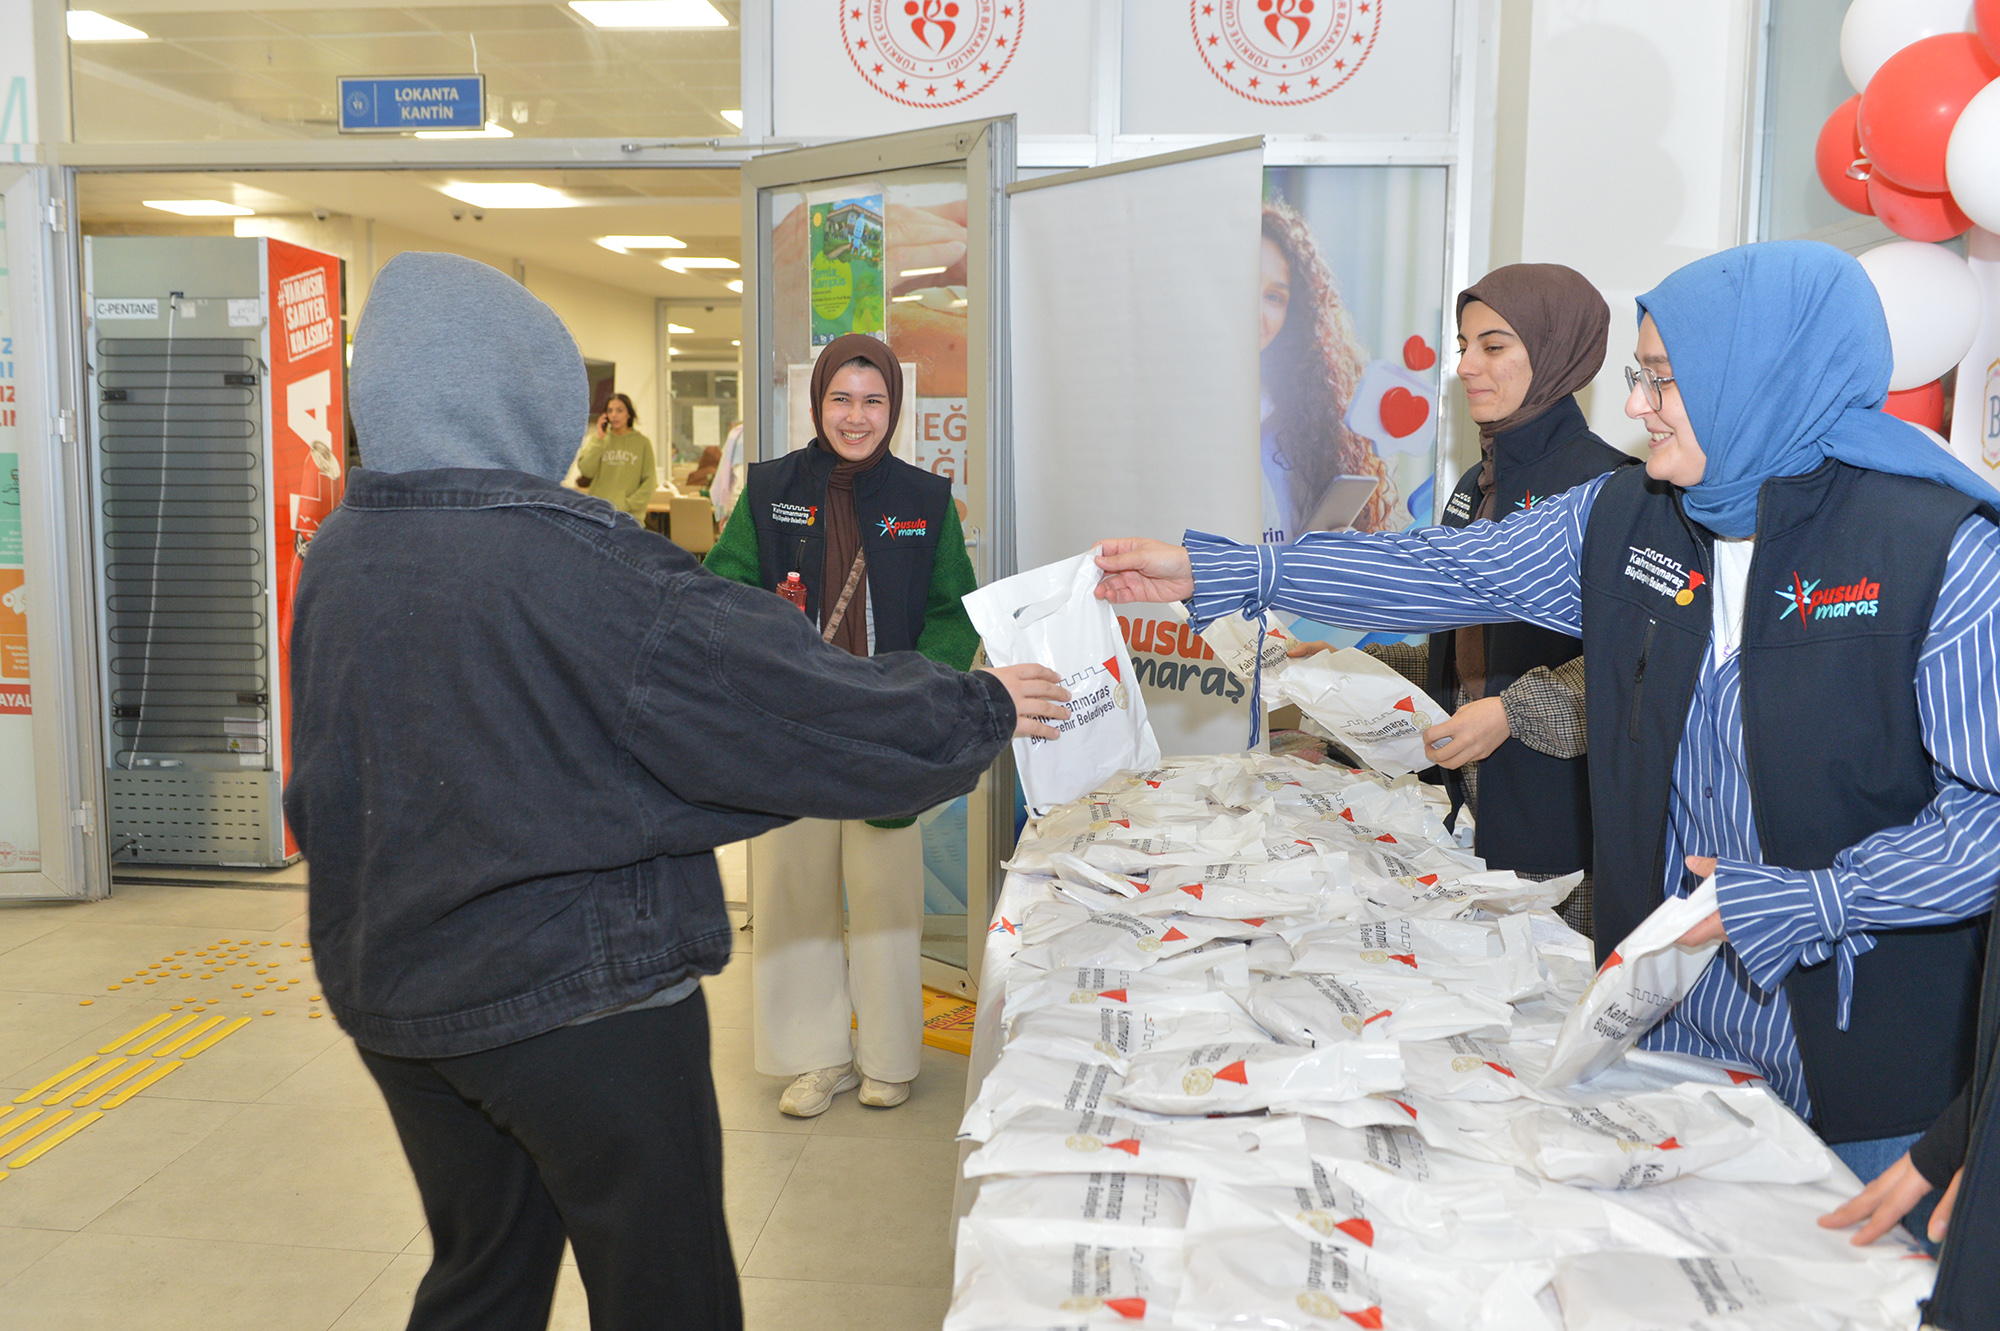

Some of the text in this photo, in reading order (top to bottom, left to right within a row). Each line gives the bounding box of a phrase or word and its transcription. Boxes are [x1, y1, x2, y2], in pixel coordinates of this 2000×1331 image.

[946, 16, 990, 71] BAKANLIĞI
[1301, 12, 1346, 68] BAKANLIĞI
[394, 86, 460, 102] LOKANTA
[401, 103, 454, 120] KANTİN
[97, 302, 158, 315] C-PENTANE
[286, 296, 327, 332] SARIYER
[894, 518, 927, 534] pusula
[897, 527, 926, 537] maraş
[1807, 577, 1881, 616] pusula
[1814, 599, 1879, 621] maraş
[1130, 656, 1246, 704] maraş
[1076, 697, 1116, 727] Belediyesi
[926, 1006, 977, 1031] CAUTION
